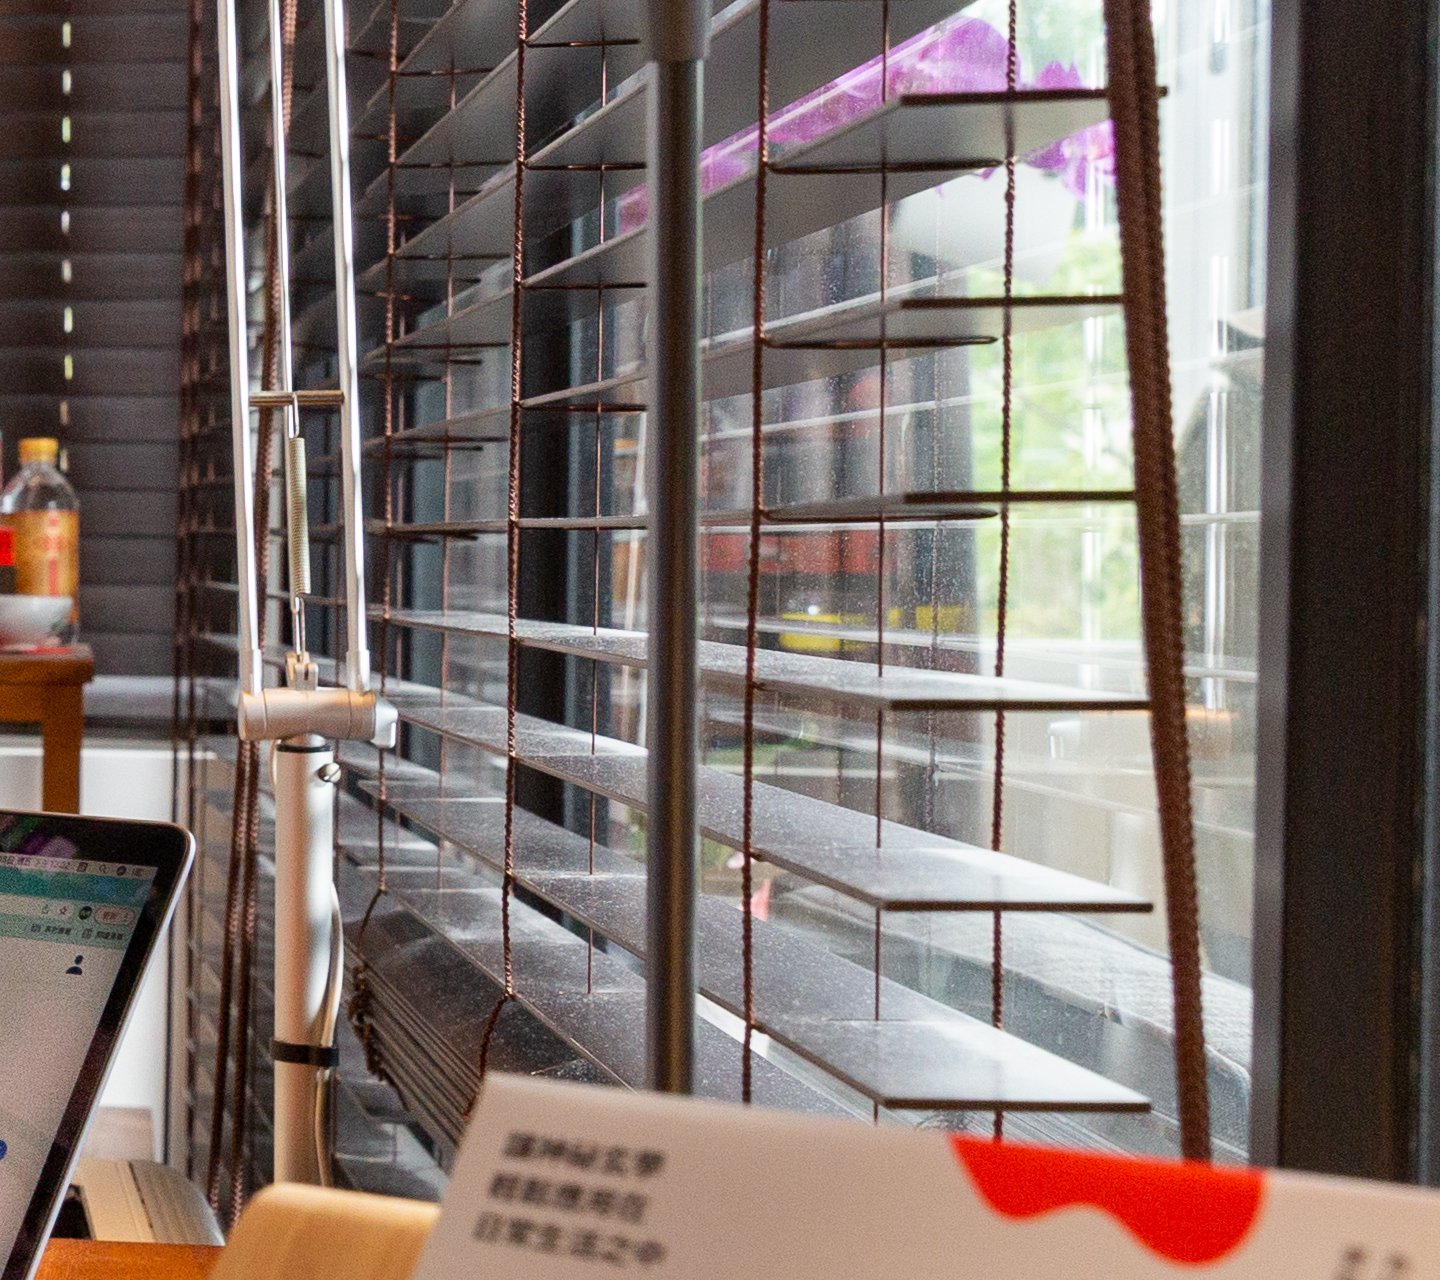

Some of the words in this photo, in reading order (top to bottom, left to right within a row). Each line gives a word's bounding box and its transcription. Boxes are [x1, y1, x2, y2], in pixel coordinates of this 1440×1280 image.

[472, 1209, 668, 1269] 日常生活之中
